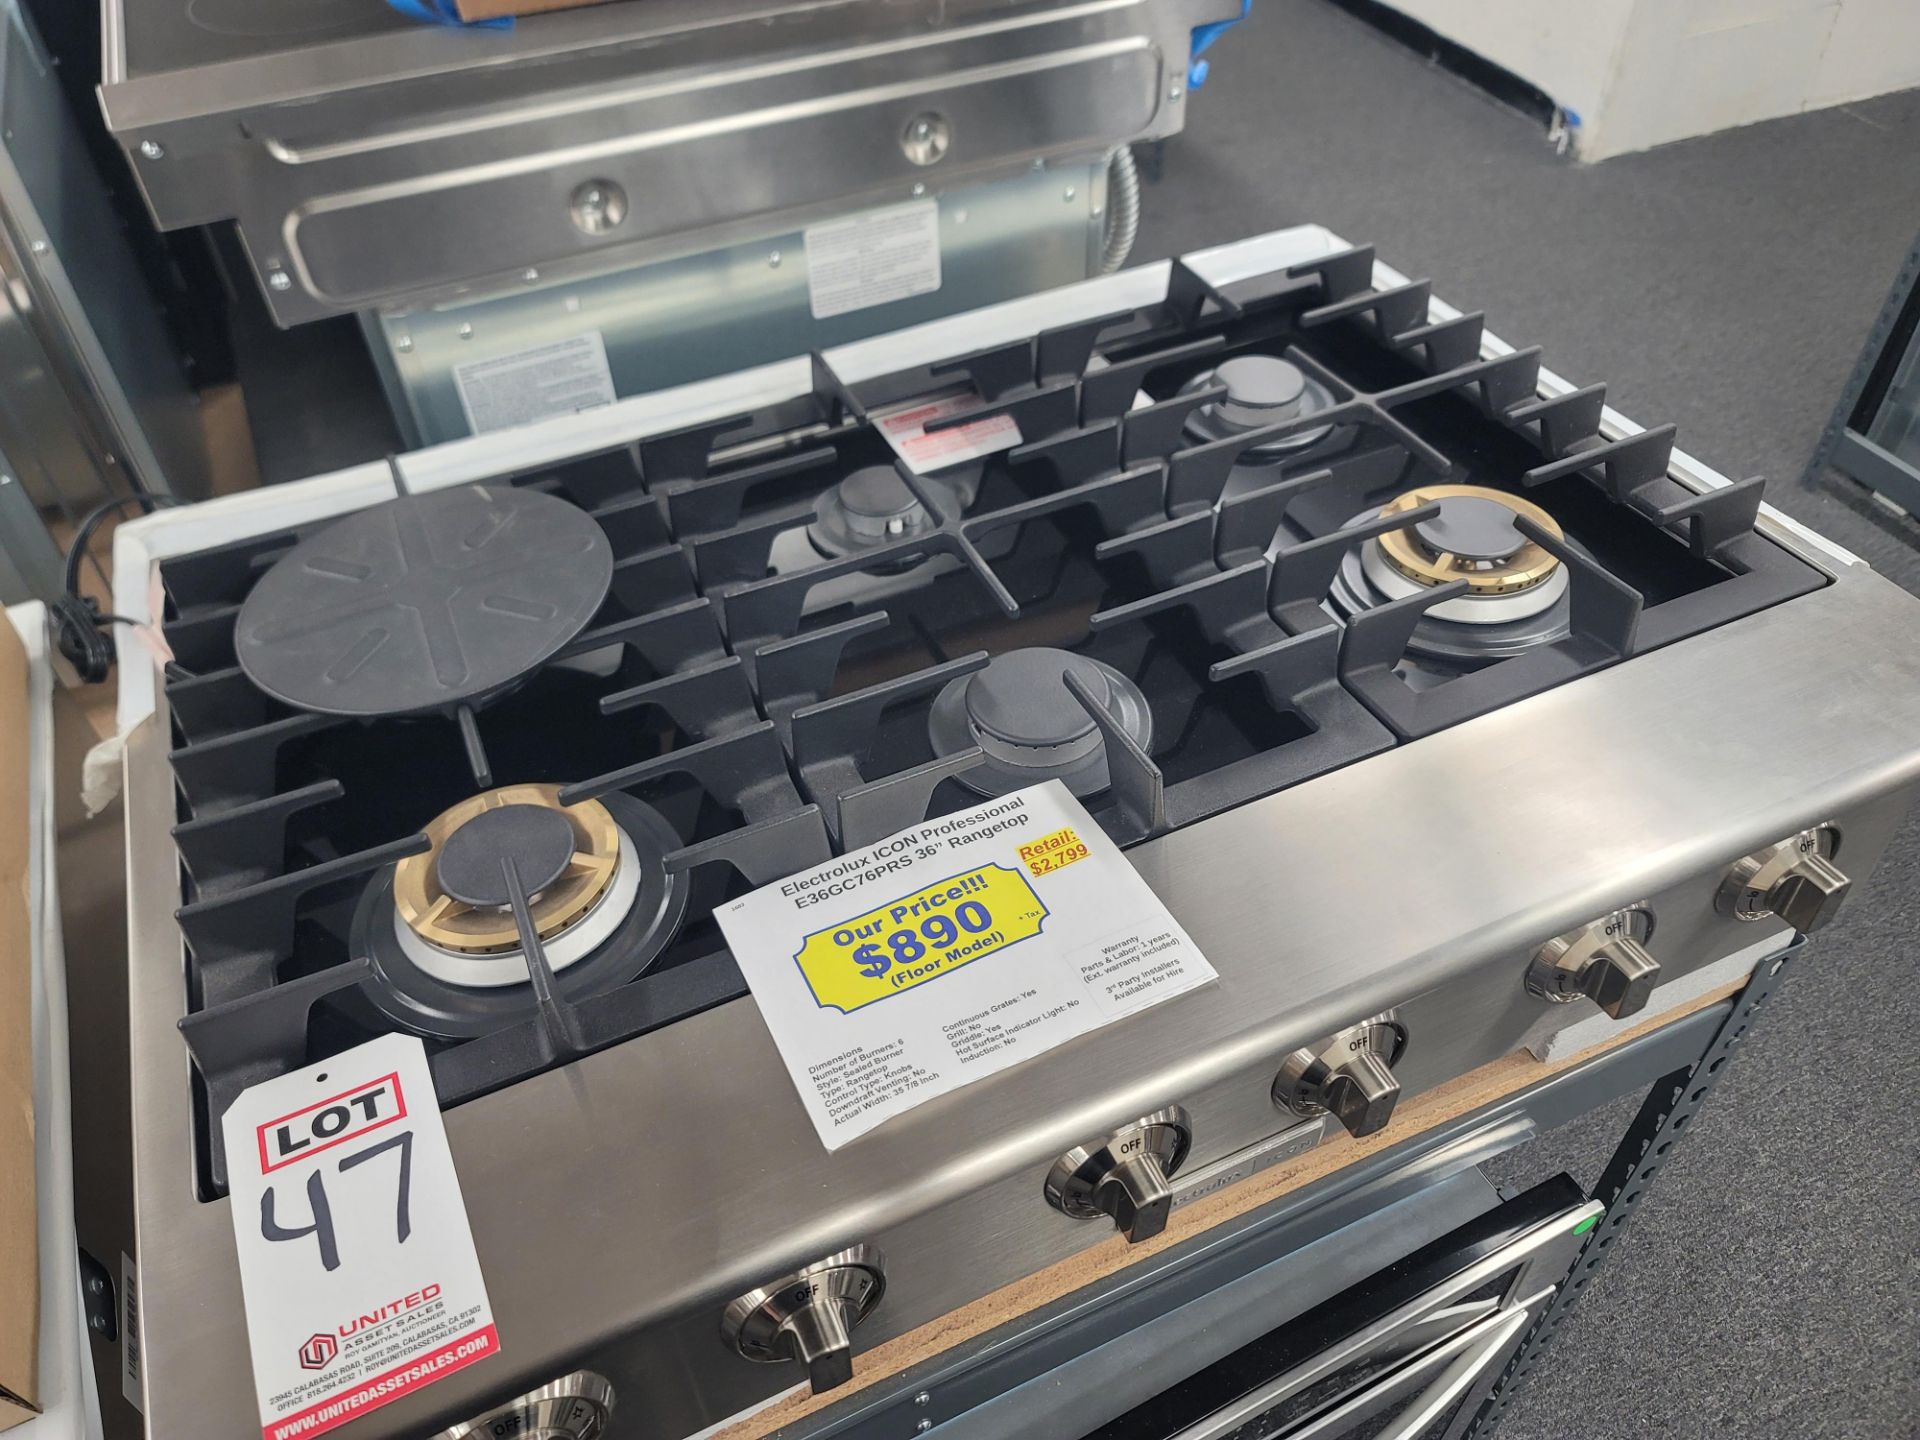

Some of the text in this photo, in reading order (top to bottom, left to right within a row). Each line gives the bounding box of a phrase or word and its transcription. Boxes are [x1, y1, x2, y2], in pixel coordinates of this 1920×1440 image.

[780, 796, 1025, 897] Electrolux ICON Professional
[794, 854, 913, 910] E36GC76PRS
[948, 813, 1029, 849] Rangetop
[1019, 830, 1078, 860] Retail:
[1030, 843, 1089, 876] $2,799
[1800, 839, 1815, 853] OFF
[833, 874, 989, 946] Our Price!!!
[1025, 909, 1041, 920] Tax
[1605, 922, 1622, 936] OFF
[852, 900, 993, 980] $890
[891, 931, 1005, 988] (Floor Model)
[1080, 960, 1104, 974] Parts
[1105, 956, 1112, 964] &
[1112, 944, 1141, 960] Labor:
[1148, 932, 1171, 945] years
[1083, 938, 1180, 984] (Ext. warranty included)
[1100, 935, 1139, 955] Warranty
[1113, 967, 1184, 1001] Available for Hire
[1118, 975, 1141, 989] Party
[1141, 958, 1180, 978] Installers
[942, 989, 1037, 1033] Continuous Grates: Yes
[946, 1022, 982, 1041] Grill: No
[955, 999, 1080, 1056] Hot Surface Indicator Light: No
[951, 1024, 1002, 1048] Griddle: Yes
[960, 1037, 1017, 1064] Induction: No
[1349, 1036, 1368, 1052] OFF
[808, 1046, 863, 1075] Dimensions
[812, 1038, 904, 1083] Number of Burners: 6
[816, 1048, 904, 1091] Style: Sealed Burner
[820, 1064, 888, 1099] Type: Rangetop
[824, 1064, 913, 1108] Control Type: Knobs
[828, 1068, 926, 1118] Downdraft Venting: No
[834, 1072, 940, 1127] Actual Width: 35 7/8 Inch
[276, 1087, 386, 1156] LOT
[1120, 1138, 1142, 1154] OFF
[260, 1130, 414, 1272] 47
[338, 1283, 441, 1337] UNITED
[795, 1284, 819, 1301] OFF
[344, 1301, 444, 1351] ASSET SALES
[344, 1346, 362, 1360] ROY
[401, 1310, 446, 1334] AUCTIONEER
[277, 1396, 303, 1412] OFFICE
[365, 1317, 476, 1373] ROY@UNITEDASSETSALES.COM
[294, 1370, 339, 1394] CALABASAS
[339, 1360, 363, 1375] ROAD,
[364, 1349, 386, 1367] SUITE
[403, 1321, 448, 1347] CALABASAS,
[448, 1315, 460, 1325] CA
[460, 1305, 481, 1320] 91302
[274, 1334, 489, 1440] WWW.UNITEDASSETSALES.COM
[493, 1416, 521, 1436] OFF
